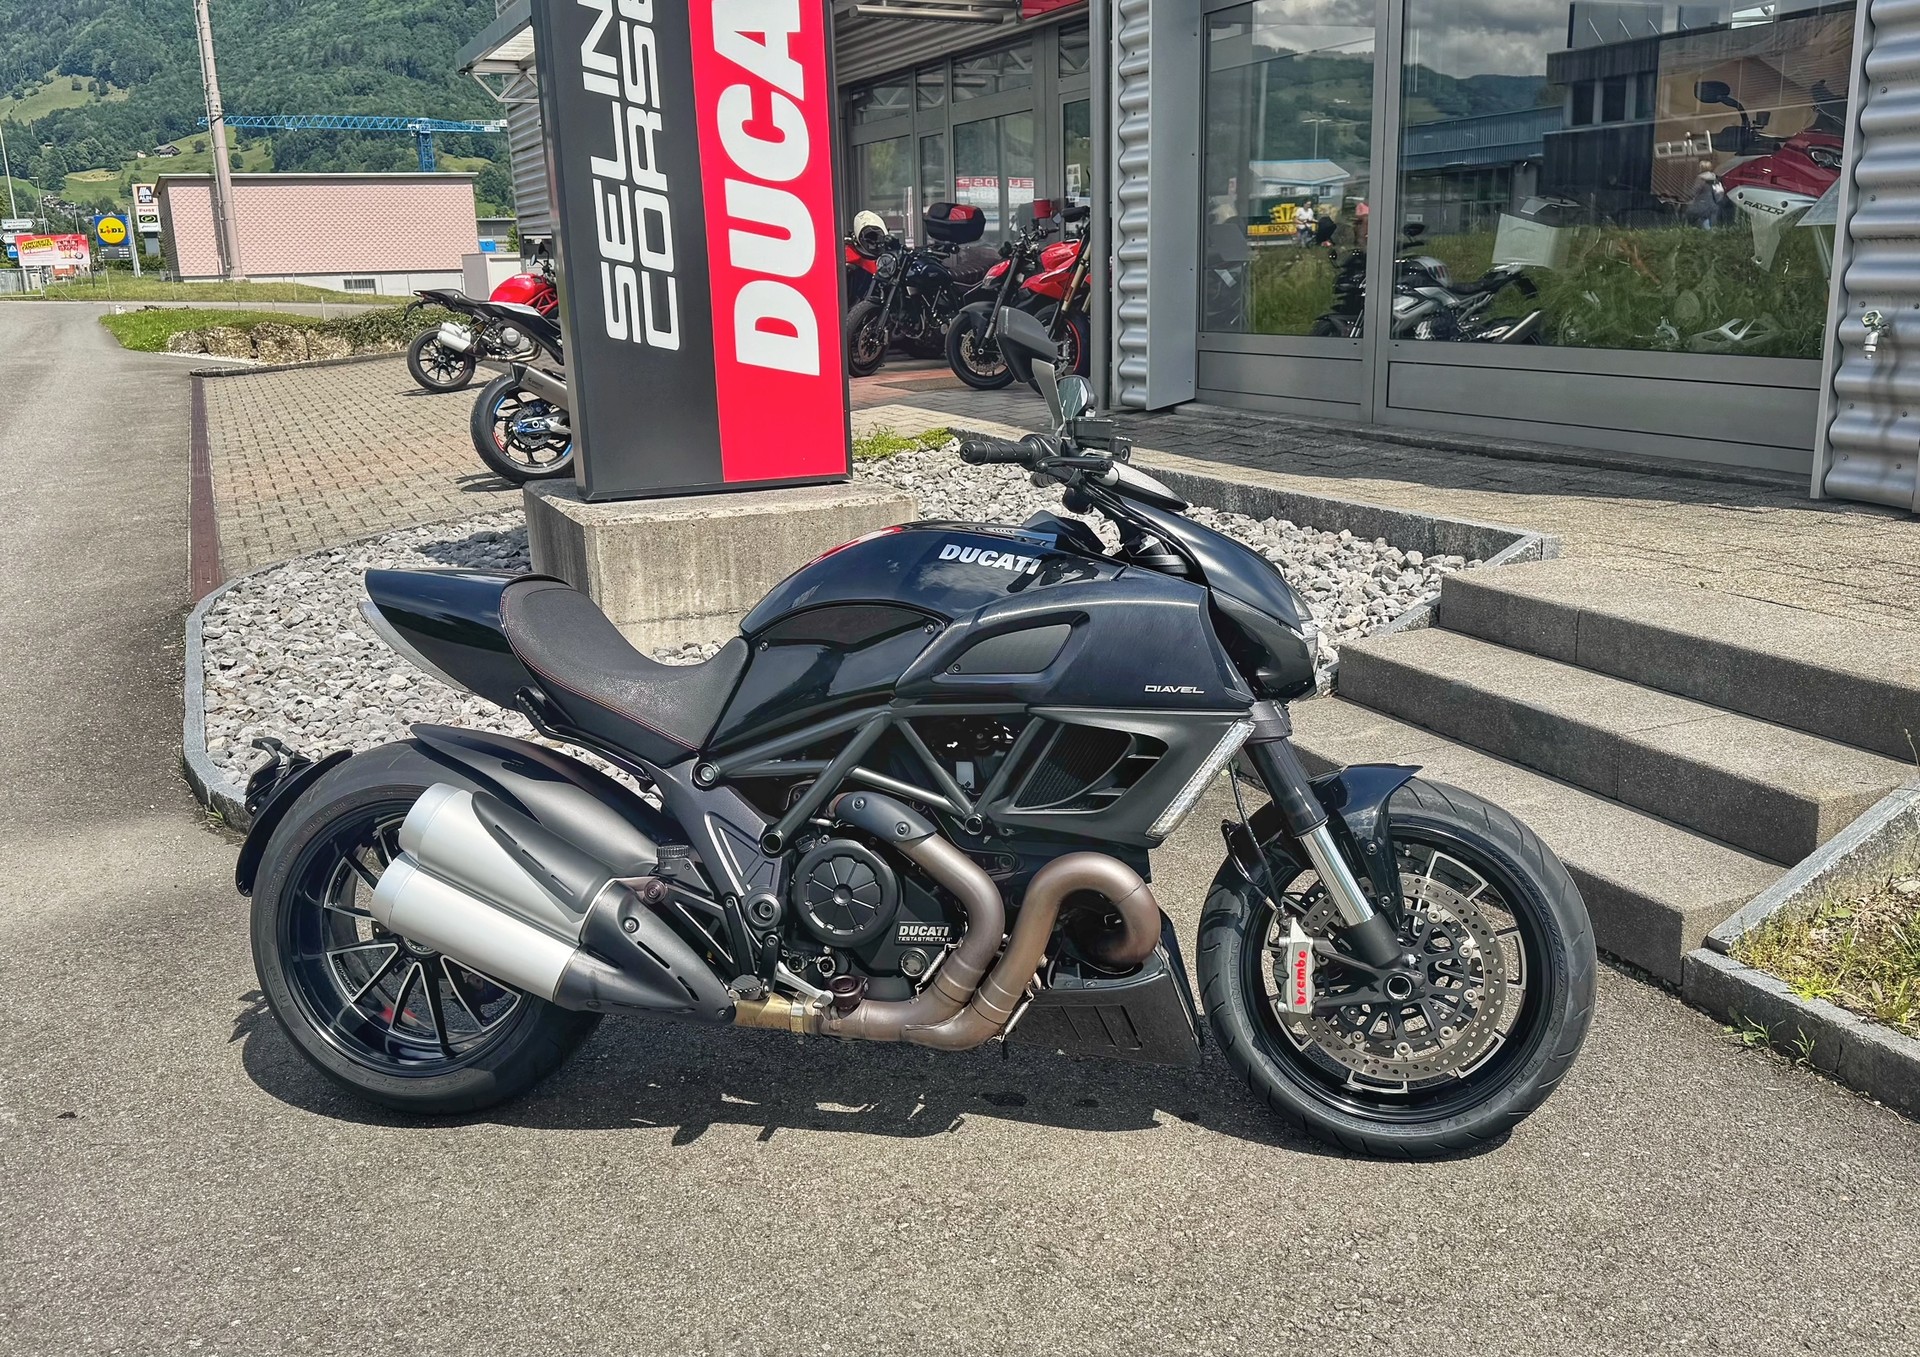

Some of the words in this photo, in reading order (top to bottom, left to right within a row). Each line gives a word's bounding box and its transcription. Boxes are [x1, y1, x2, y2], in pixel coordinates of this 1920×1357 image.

[577, 0, 642, 344] SELIN
[617, 0, 681, 351] CORS
[711, 0, 821, 376] DUCA
[938, 543, 1043, 576] DUCATI
[1144, 684, 1205, 694] DIAVEL
[898, 925, 950, 937] DUCATI
[1293, 950, 1308, 1006] brembo
